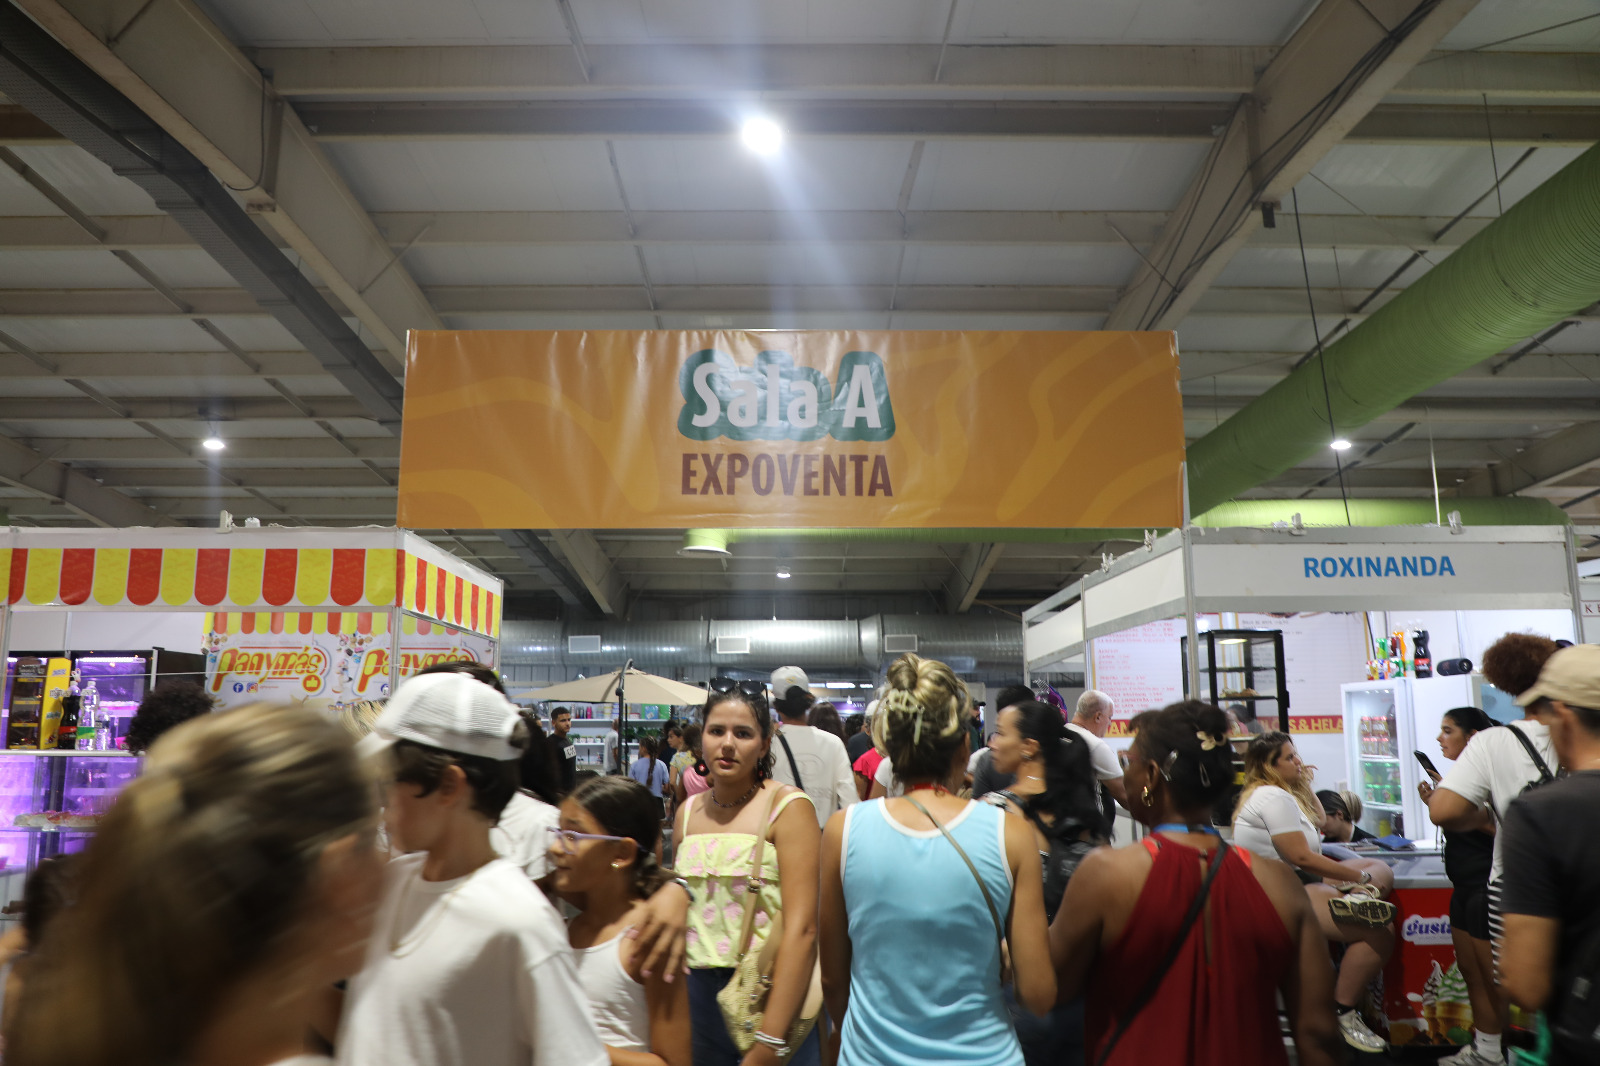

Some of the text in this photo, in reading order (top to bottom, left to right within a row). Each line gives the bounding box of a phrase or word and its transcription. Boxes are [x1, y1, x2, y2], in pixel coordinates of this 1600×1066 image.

[691, 362, 882, 428] Sala A
[681, 453, 893, 497] EXPOVENTA
[1303, 556, 1456, 578] ROXINANDA
